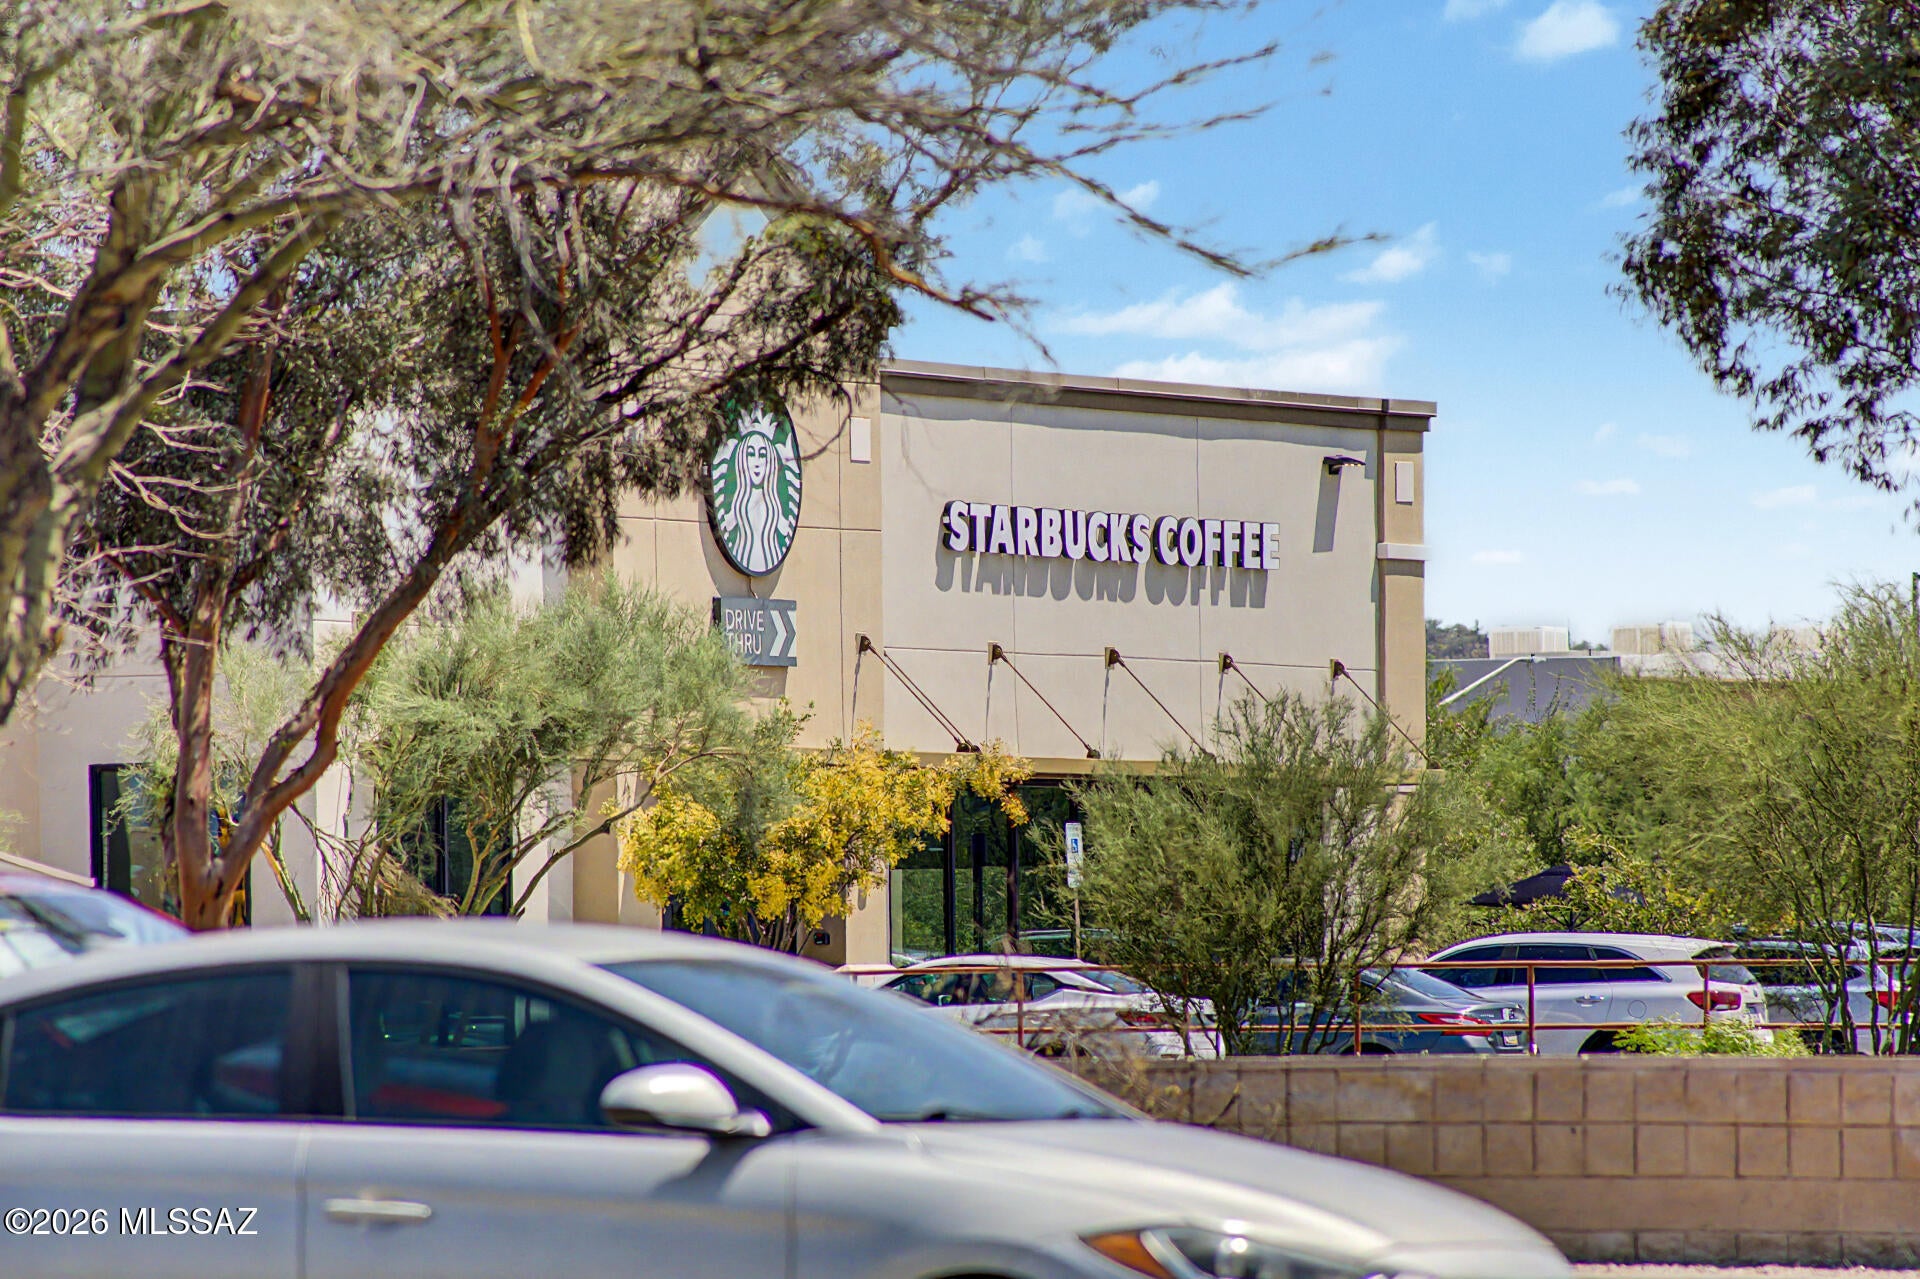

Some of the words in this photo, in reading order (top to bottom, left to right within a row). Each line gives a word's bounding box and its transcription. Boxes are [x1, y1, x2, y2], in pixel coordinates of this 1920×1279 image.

[943, 500, 1151, 565] STARBUCKS
[1154, 516, 1281, 570] COFFEE
[725, 608, 765, 632] DRIVE
[726, 632, 762, 655] THRU
